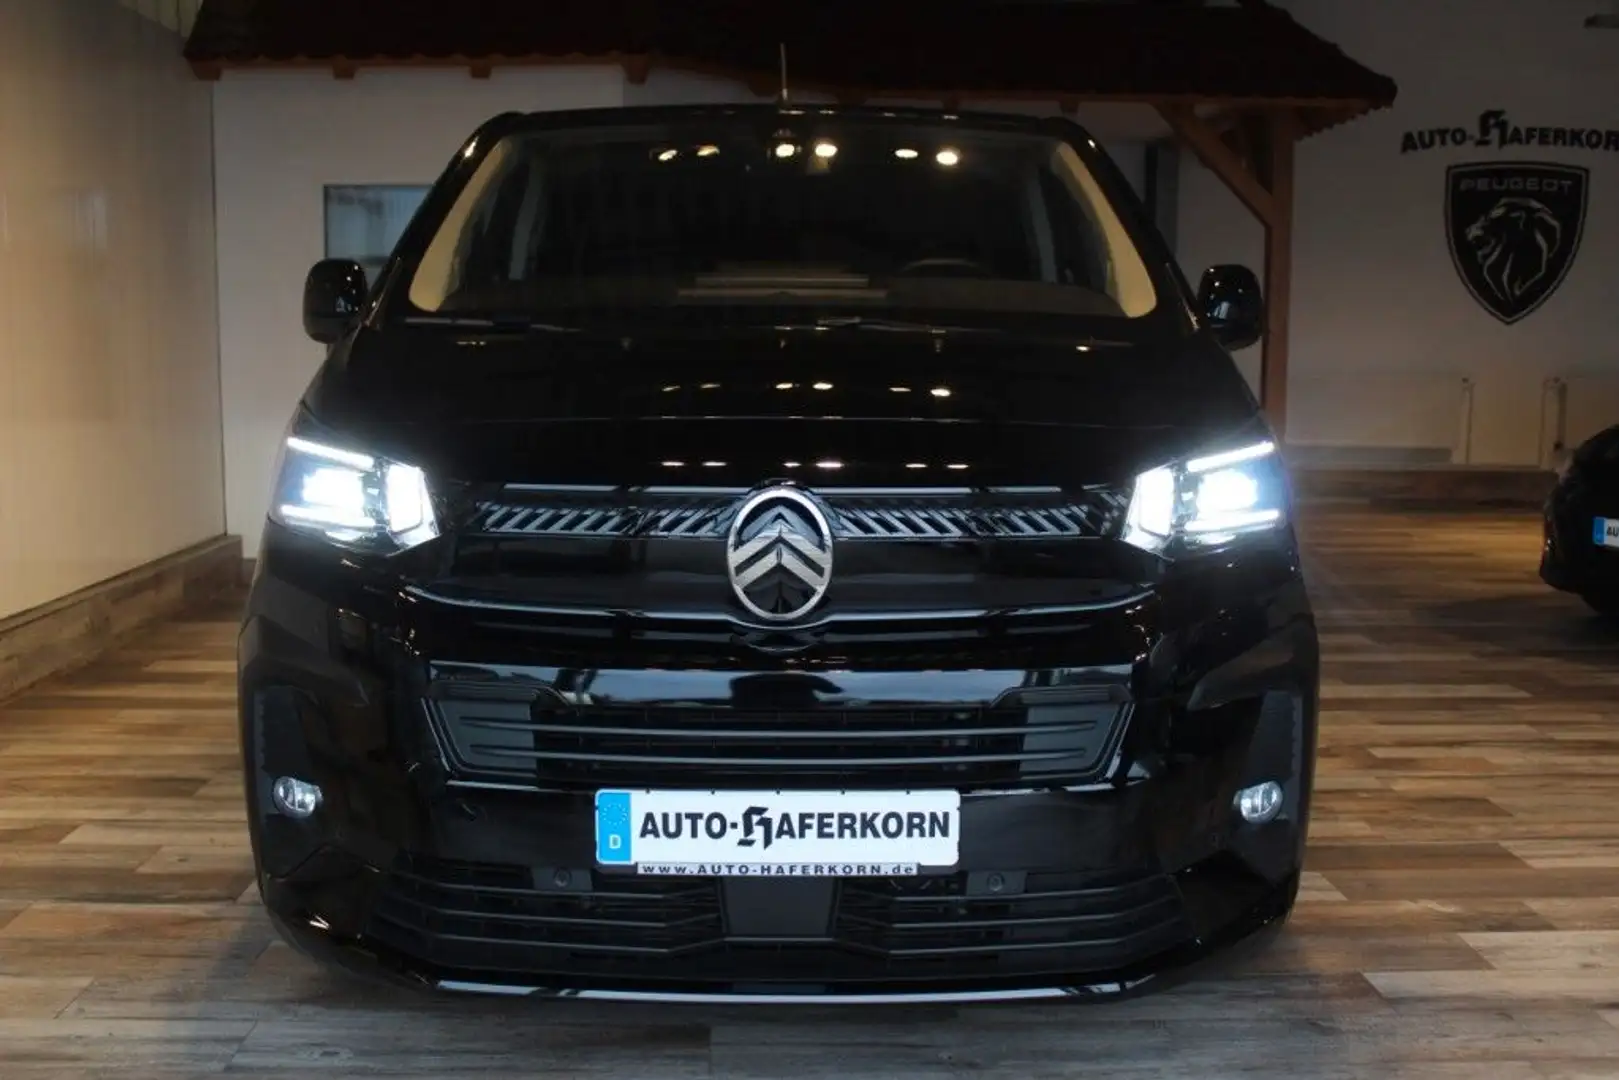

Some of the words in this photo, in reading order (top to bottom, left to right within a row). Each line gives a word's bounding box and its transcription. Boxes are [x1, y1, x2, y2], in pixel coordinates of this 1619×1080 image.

[1460, 177, 1573, 193] PEUGEOT
[639, 806, 950, 849] AUTO-HAFERKORN
[608, 834, 621, 849] D
[642, 863, 914, 875] www.AUTO-HAFERKORN.de
